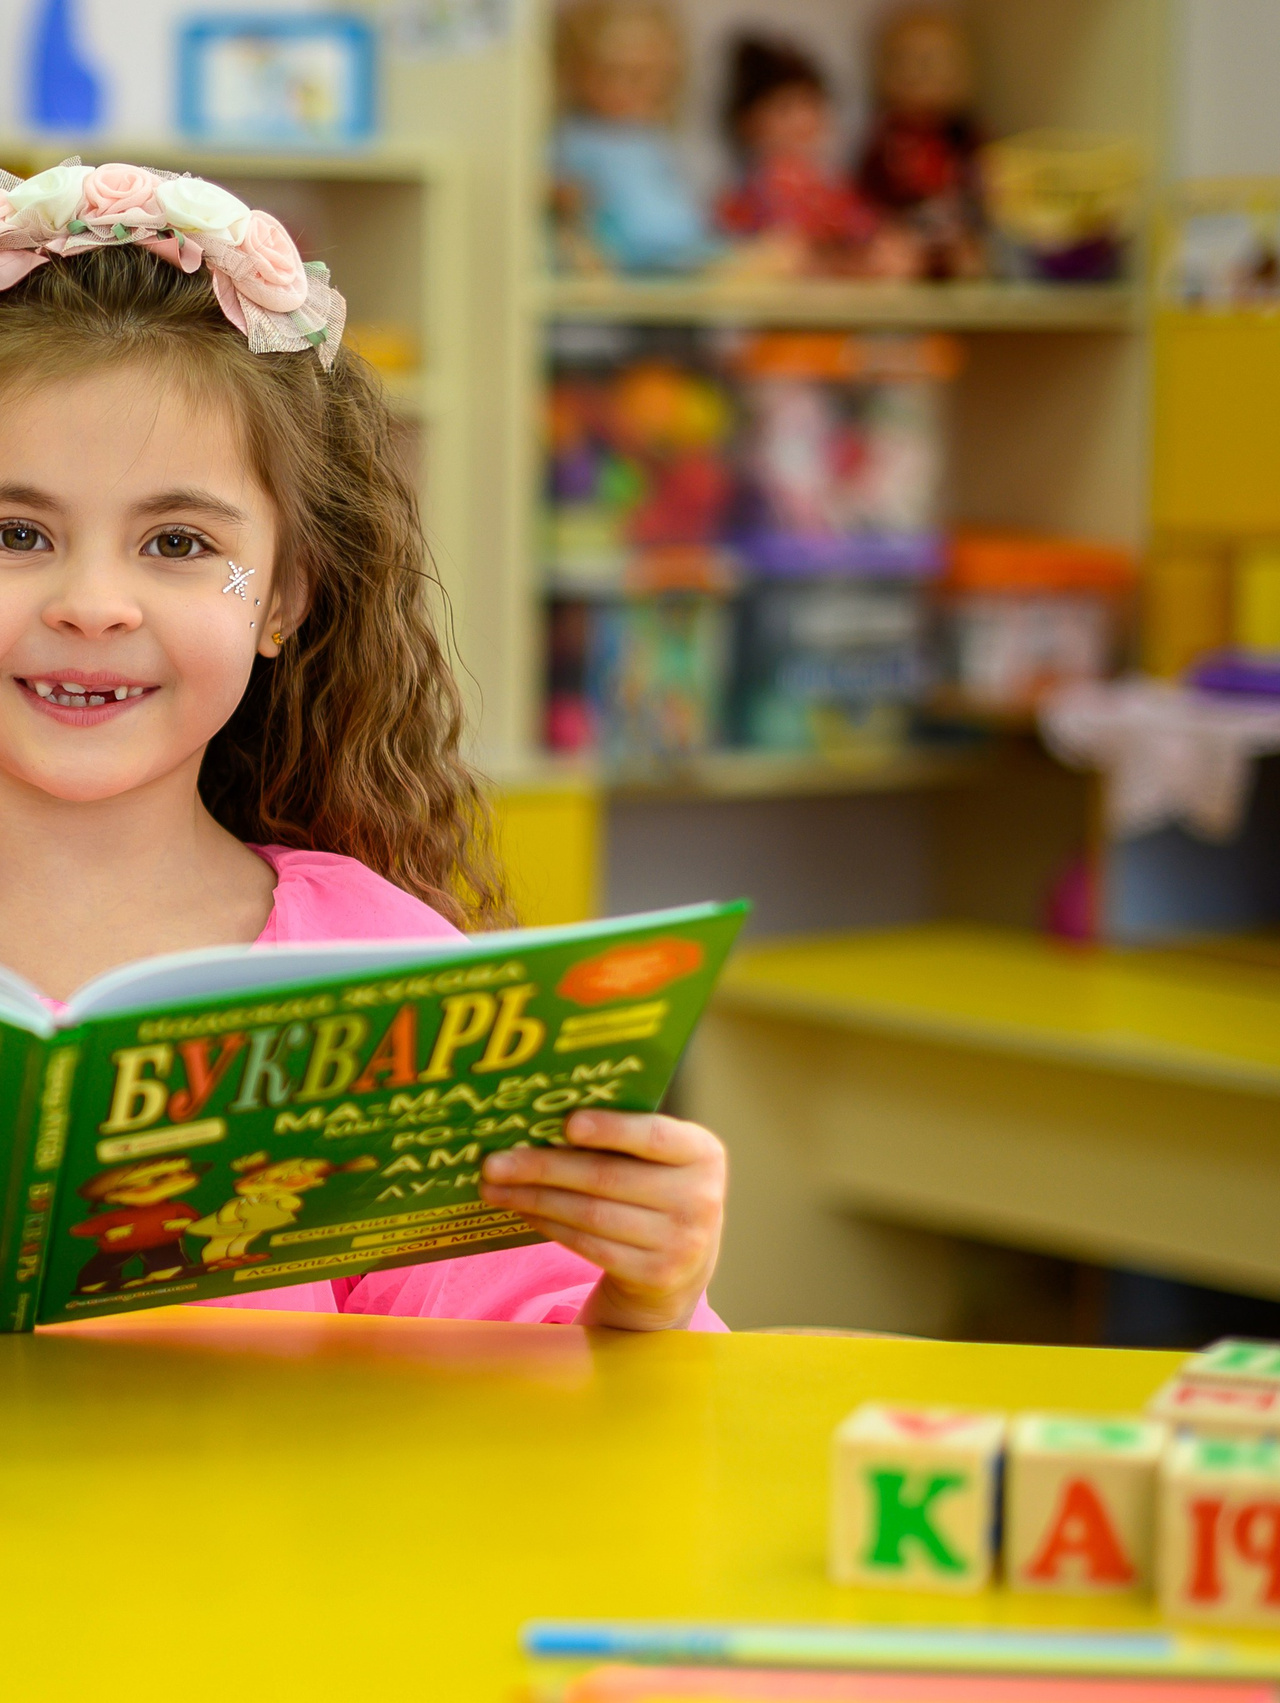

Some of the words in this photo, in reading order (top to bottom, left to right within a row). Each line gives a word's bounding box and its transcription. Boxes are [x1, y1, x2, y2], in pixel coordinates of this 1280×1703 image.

[100, 983, 547, 1135] БУКВАРЬ
[273, 1083, 473, 1135] МА-МА
[496, 1055, 643, 1095] РА-МА
[531, 1079, 623, 1113] ОХ
[391, 1113, 527, 1150] РО-ЗА
[376, 1171, 480, 1201] ЛУ-Н
[280, 1217, 398, 1243] СОЧЕТАНИЕ
[407, 1200, 489, 1222] ТРАДИЦ
[381, 1230, 396, 1242] И
[246, 1237, 438, 1277] ЛОГОПЕДИЧЕСКОЙ
[450, 1222, 533, 1244] МЕТОДИ
[862, 1467, 972, 1580] К
[1022, 1474, 1140, 1588] А
